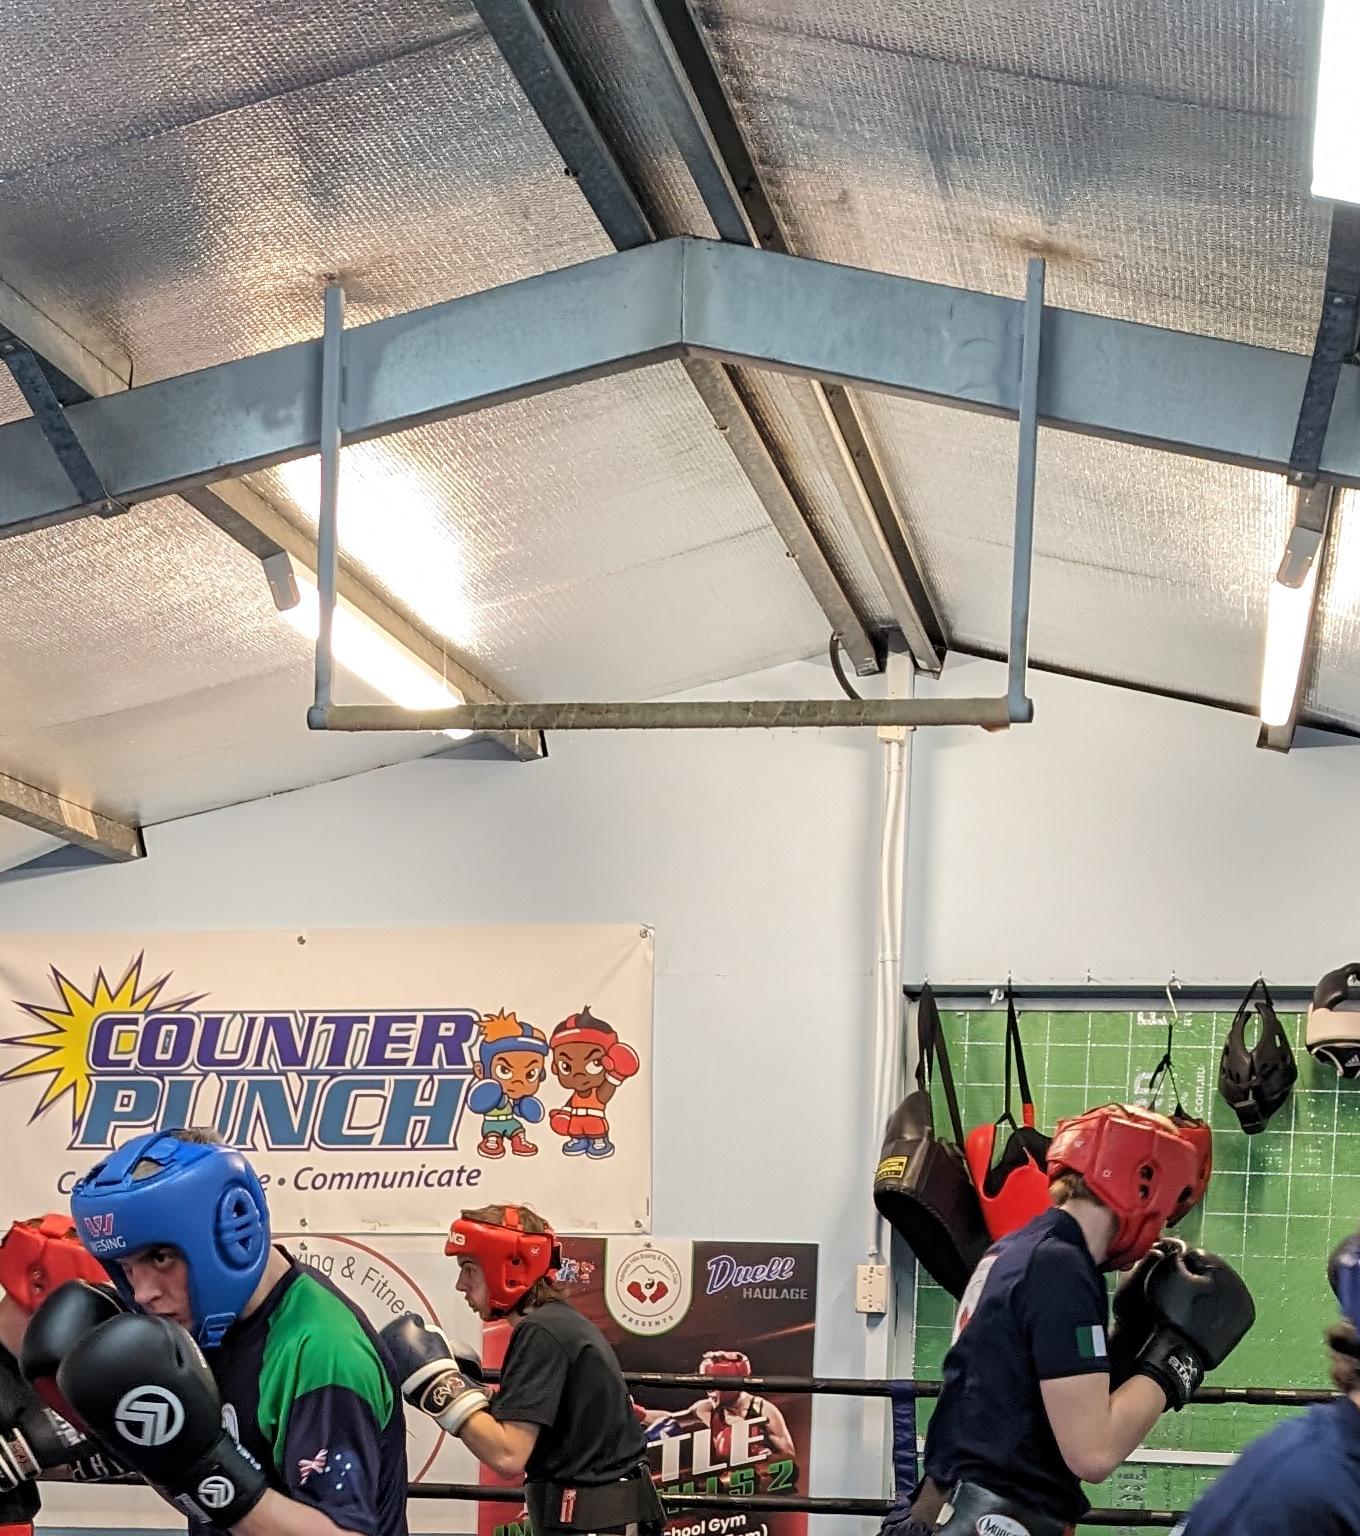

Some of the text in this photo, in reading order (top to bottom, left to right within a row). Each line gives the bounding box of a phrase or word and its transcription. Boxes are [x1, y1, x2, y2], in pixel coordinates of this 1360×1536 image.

[90, 1010, 476, 1072] COUNTER
[70, 1075, 468, 1150] PUNCH
[294, 1164, 482, 1190] Communicate
[341, 1256, 355, 1281] &
[361, 1266, 410, 1316] Fitne
[706, 1255, 796, 1295] Duell
[743, 1288, 808, 1300] HAULAGE
[621, 1313, 674, 1327] PRESENTS
[646, 1416, 770, 1482] TLE
[767, 1460, 794, 1491] 2
[709, 1514, 747, 1536] Gym
